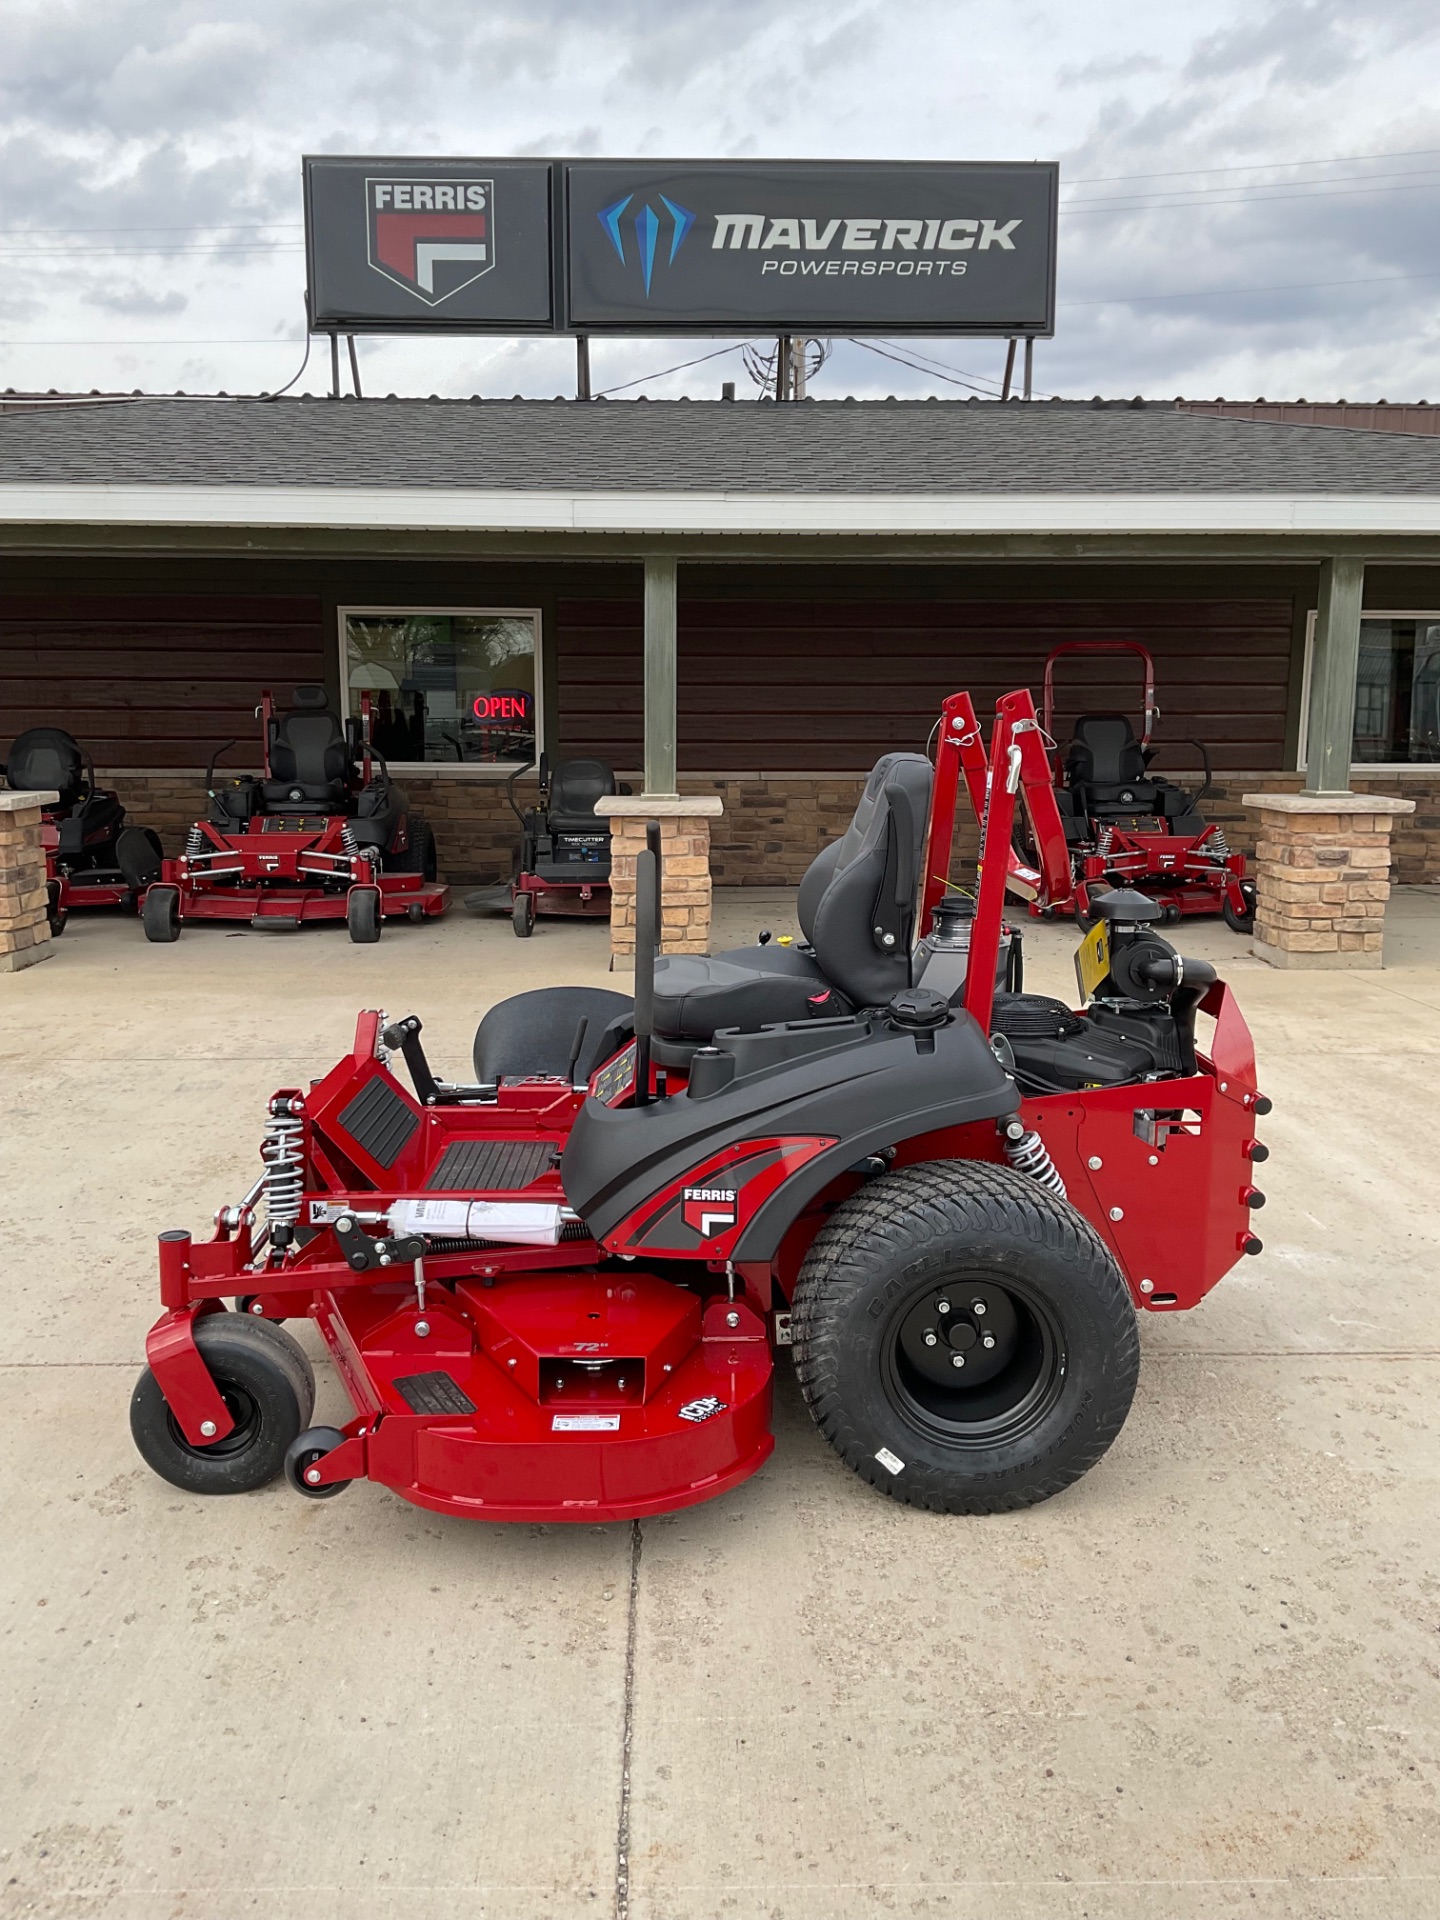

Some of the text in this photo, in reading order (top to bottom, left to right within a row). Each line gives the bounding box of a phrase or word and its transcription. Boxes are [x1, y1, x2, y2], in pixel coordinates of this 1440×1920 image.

[374, 184, 486, 210] FERRIS
[711, 213, 1023, 250] MAVERICK
[761, 260, 968, 276] POWERSPORTS
[473, 697, 525, 718] OPEN
[684, 1188, 735, 1201] FERRIS
[866, 1245, 1027, 1321] CARLISLE
